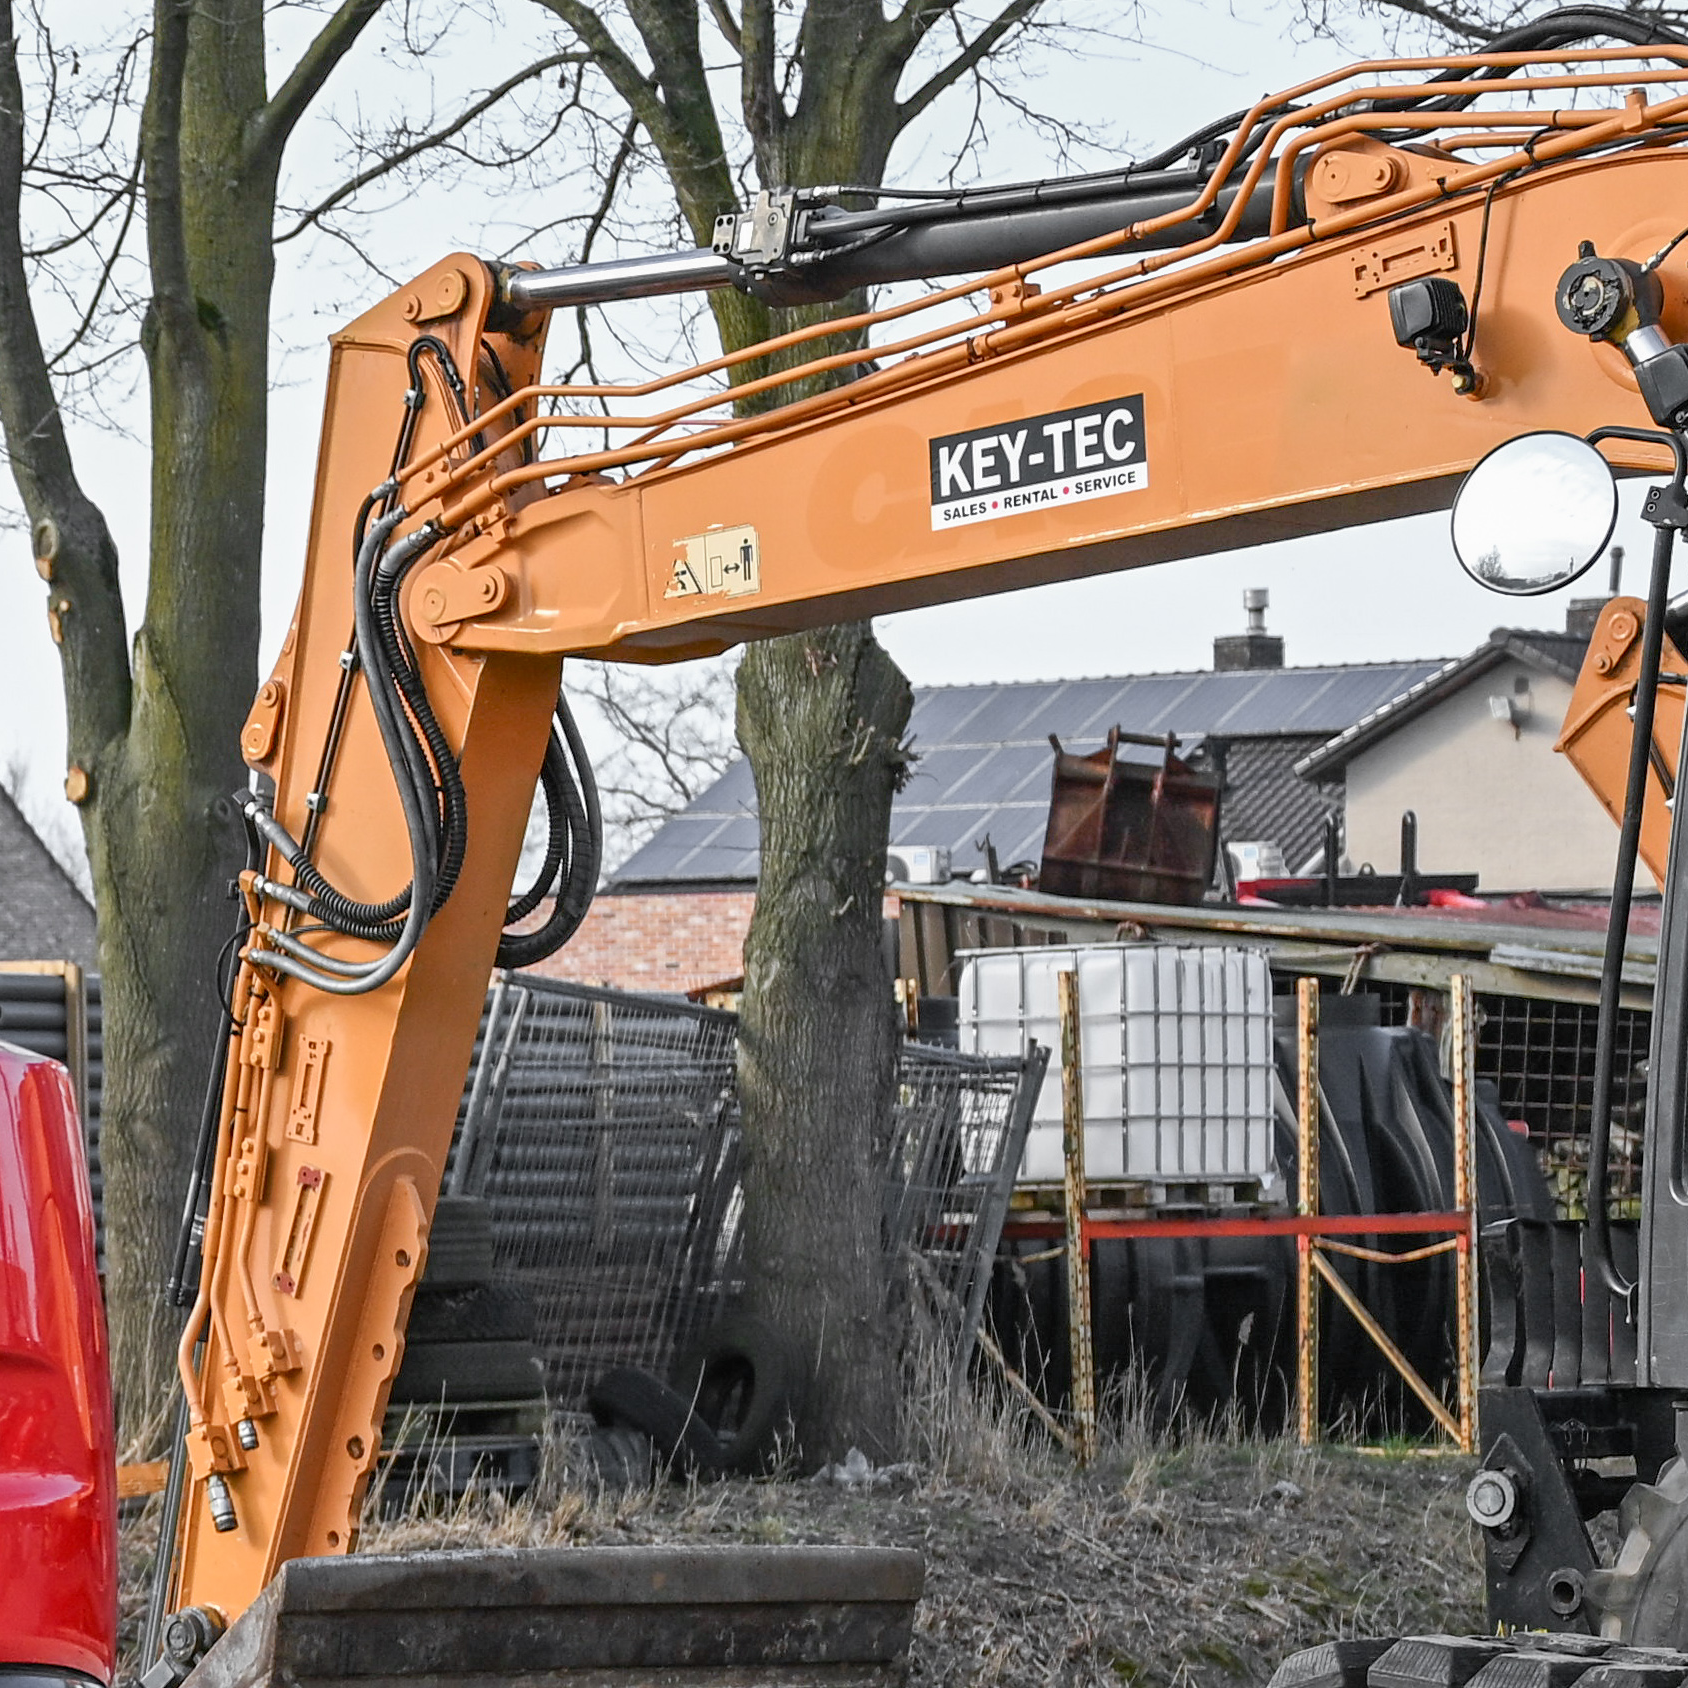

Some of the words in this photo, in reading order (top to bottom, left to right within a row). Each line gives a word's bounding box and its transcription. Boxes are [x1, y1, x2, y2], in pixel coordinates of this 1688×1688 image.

[938, 407, 1136, 498] KEY-TEC
[944, 502, 987, 521] SALES
[1004, 488, 1058, 509] RENTAL
[1075, 471, 1136, 494] SERVICE
